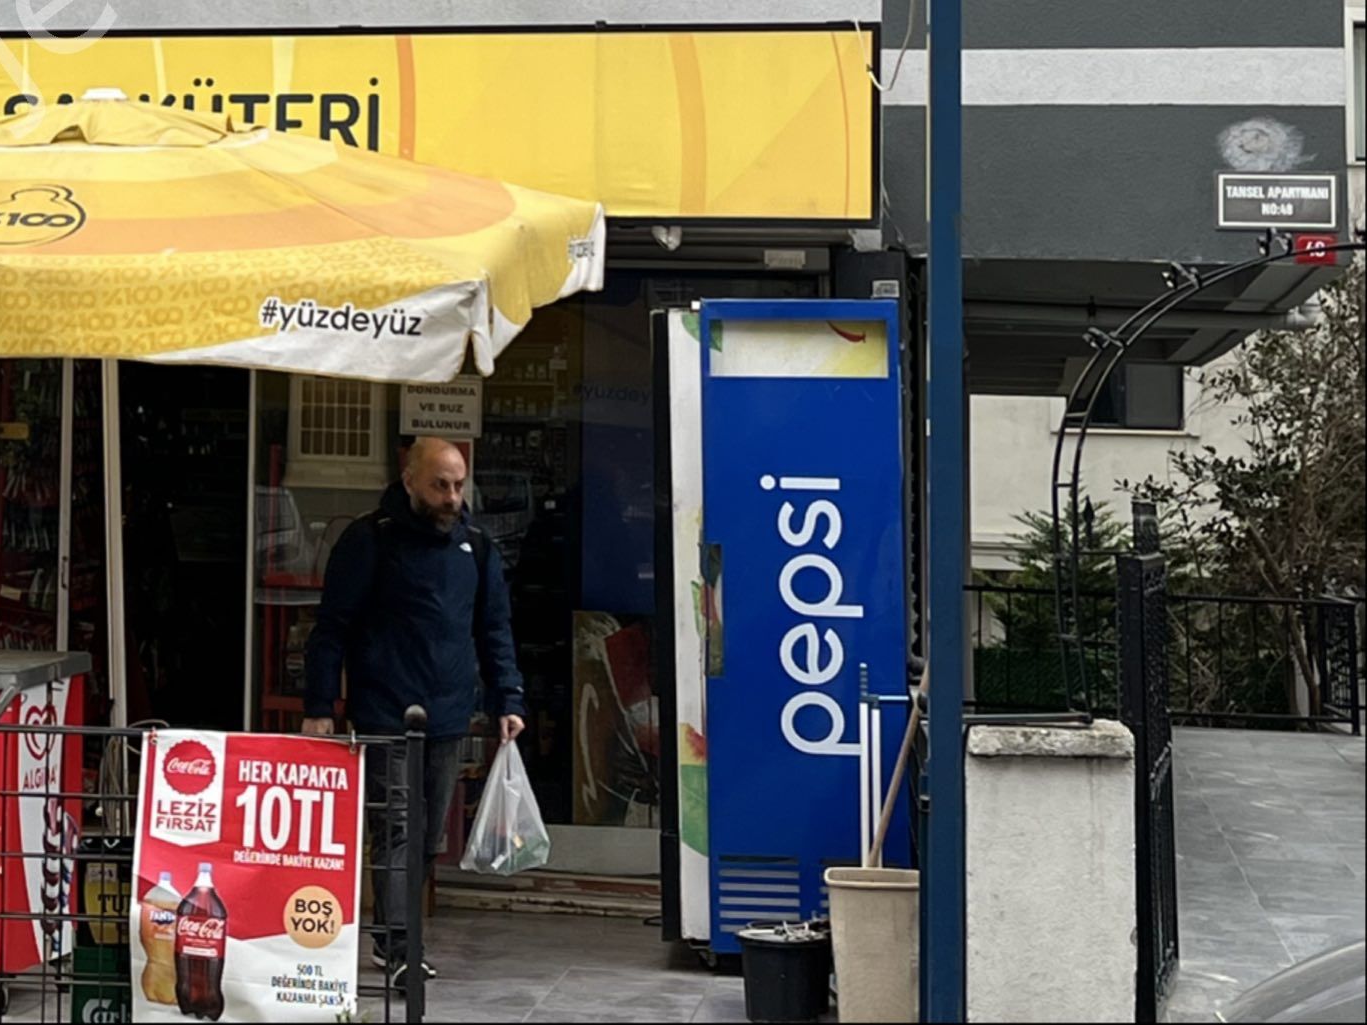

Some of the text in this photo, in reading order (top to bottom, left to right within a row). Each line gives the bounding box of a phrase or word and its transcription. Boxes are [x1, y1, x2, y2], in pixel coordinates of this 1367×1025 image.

[261, 299, 423, 339] #yüzdeyüz
[407, 384, 477, 397] DONDURMA
[419, 402, 464, 414] VE BUZ
[411, 418, 471, 430] BULUNUR
[759, 474, 864, 756] pepsi
[238, 759, 349, 791] HER KAPAKTA
[156, 798, 217, 818] LEZİZ
[155, 815, 216, 833] FIRSAT
[235, 784, 346, 856] 10TL
[97, 894, 131, 913] TU
[294, 898, 333, 919] BOŞ
[290, 916, 335, 934] YOK!
[296, 963, 324, 977] 500 TL
[271, 974, 348, 994] DEĞERİNDE BAKİYE
[276, 992, 344, 1008] KAZANMA ŞANS
[82, 998, 131, 1023] Carl
